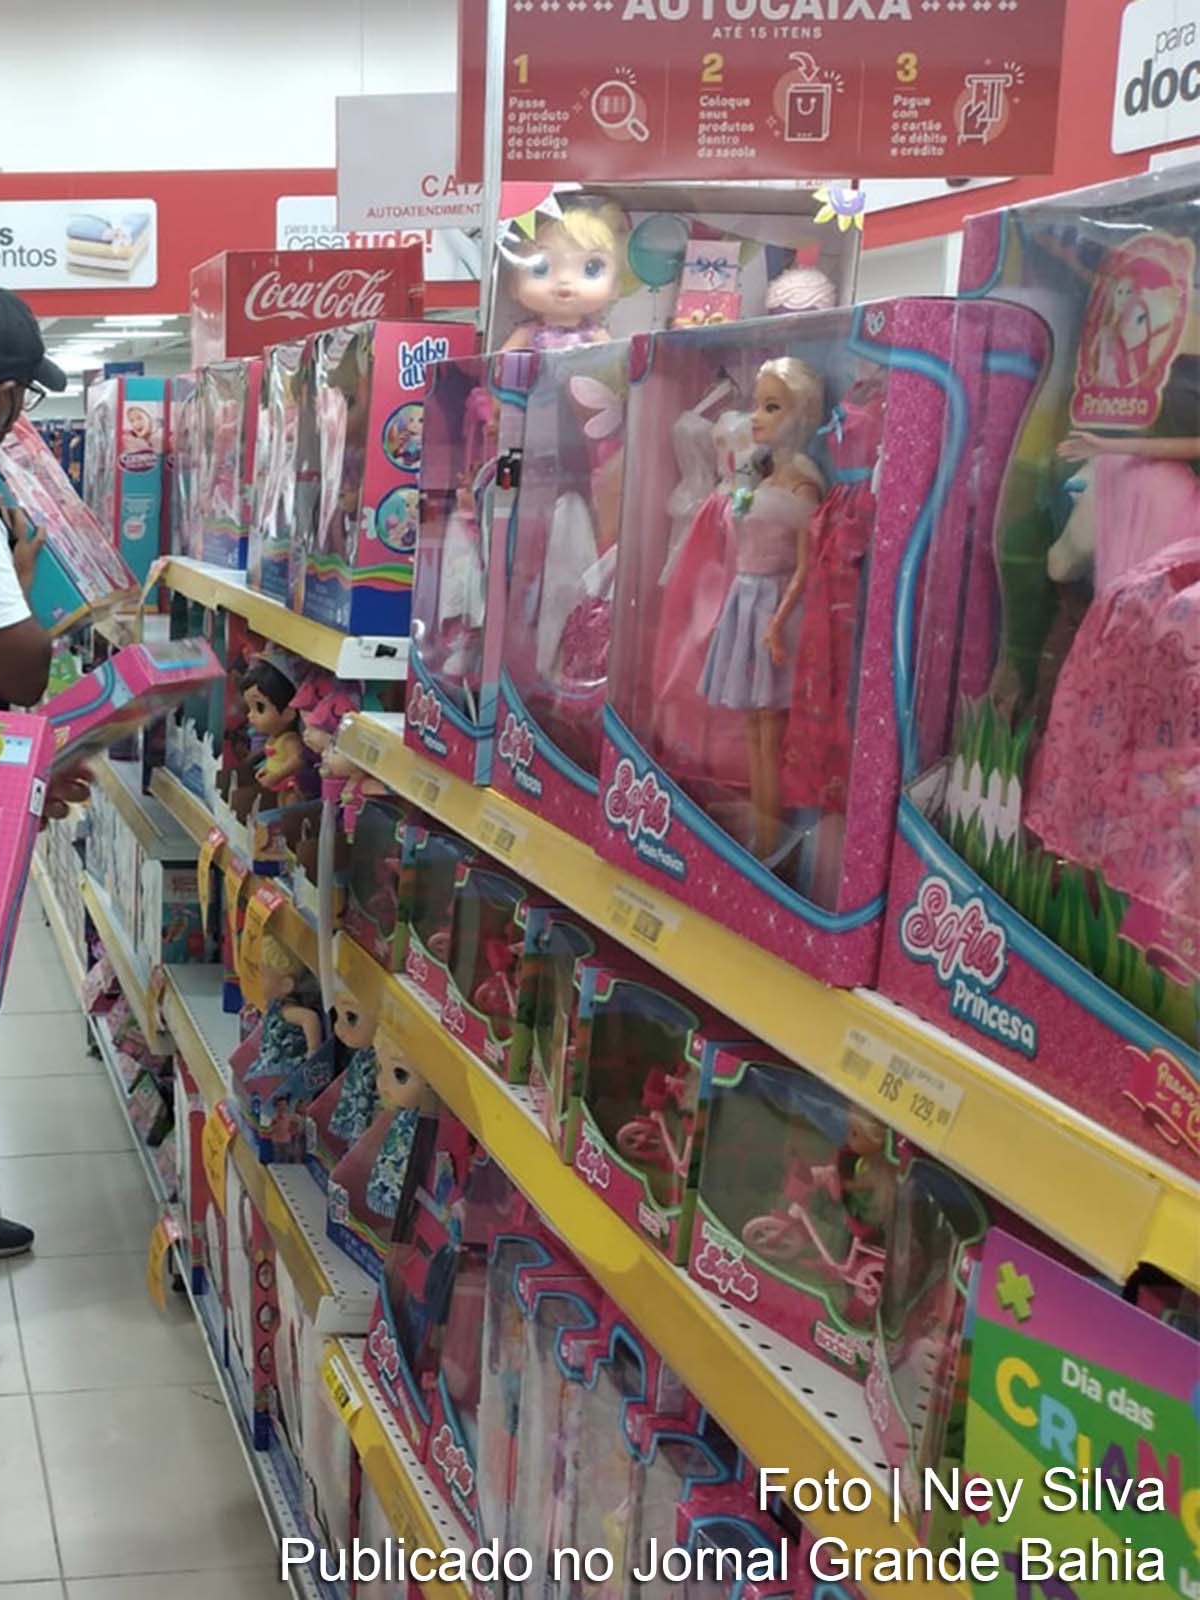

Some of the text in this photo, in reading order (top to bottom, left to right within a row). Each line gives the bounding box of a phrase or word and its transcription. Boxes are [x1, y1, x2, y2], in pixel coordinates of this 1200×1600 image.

[621, 0, 913, 21] AUTOCAIXA
[712, 25, 822, 39] ATÉ 15 ITENS
[1155, 22, 1196, 60] para
[513, 54, 529, 84] 1
[702, 53, 724, 83] 2
[896, 52, 918, 82] 3
[508, 97, 546, 109] Passe
[700, 95, 750, 109] Coloque
[893, 95, 931, 109] Pague
[519, 110, 570, 123] produto
[699, 110, 728, 119] seus
[892, 110, 918, 119] com
[508, 123, 561, 134] no leitor
[698, 122, 754, 134] produtos
[902, 120, 942, 131] cartão
[507, 135, 568, 149] de código
[698, 134, 740, 145] dentro
[891, 132, 947, 144] de débito
[507, 148, 568, 160] de barras
[900, 144, 944, 157] crédito
[366, 203, 482, 218] AUTOATENDIMENT
[245, 269, 395, 321] Coca-Cola
[401, 337, 448, 369] baby
[1082, 393, 1148, 416] Princesa
[902, 877, 1006, 983] Sofia
[953, 979, 1035, 1050] Princesa
[1061, 1358, 1155, 1431] Dia das
